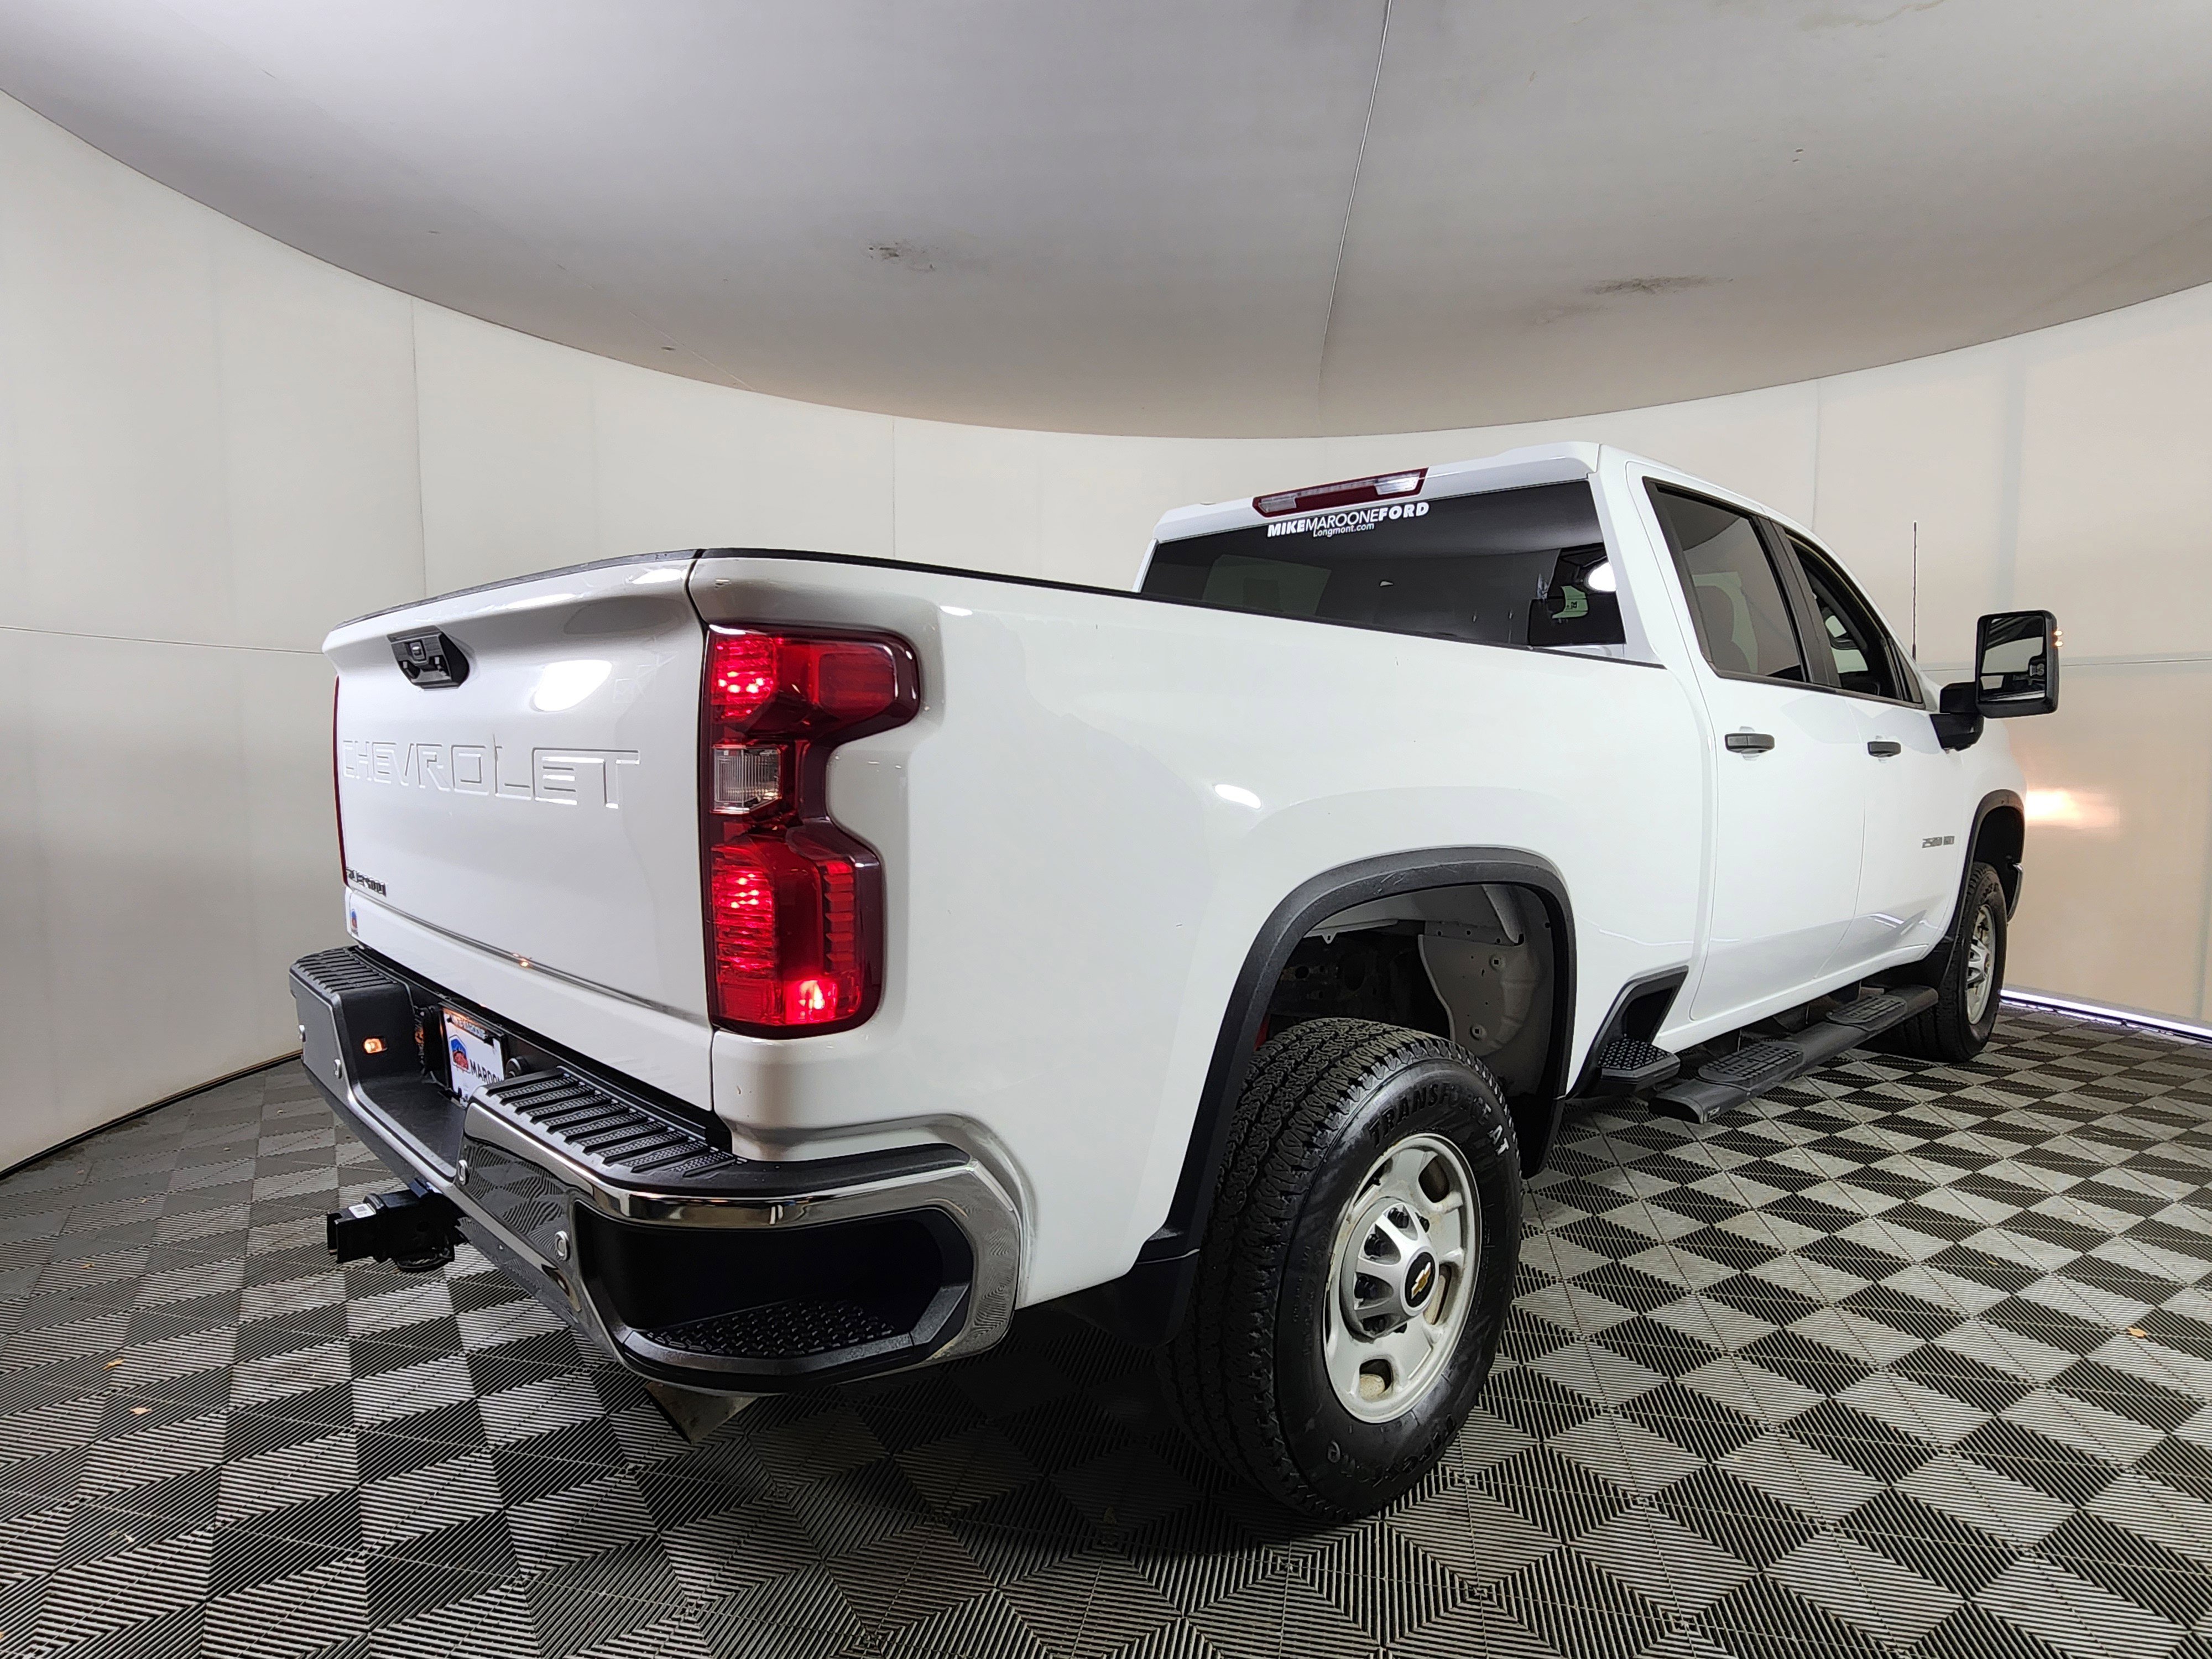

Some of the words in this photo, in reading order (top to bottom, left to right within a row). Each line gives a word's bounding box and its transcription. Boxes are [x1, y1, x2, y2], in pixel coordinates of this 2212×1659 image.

[1313, 523, 1375, 538] Longmont.com
[342, 739, 640, 809] CHEVROLET
[1487, 1124, 1510, 1156] AT
